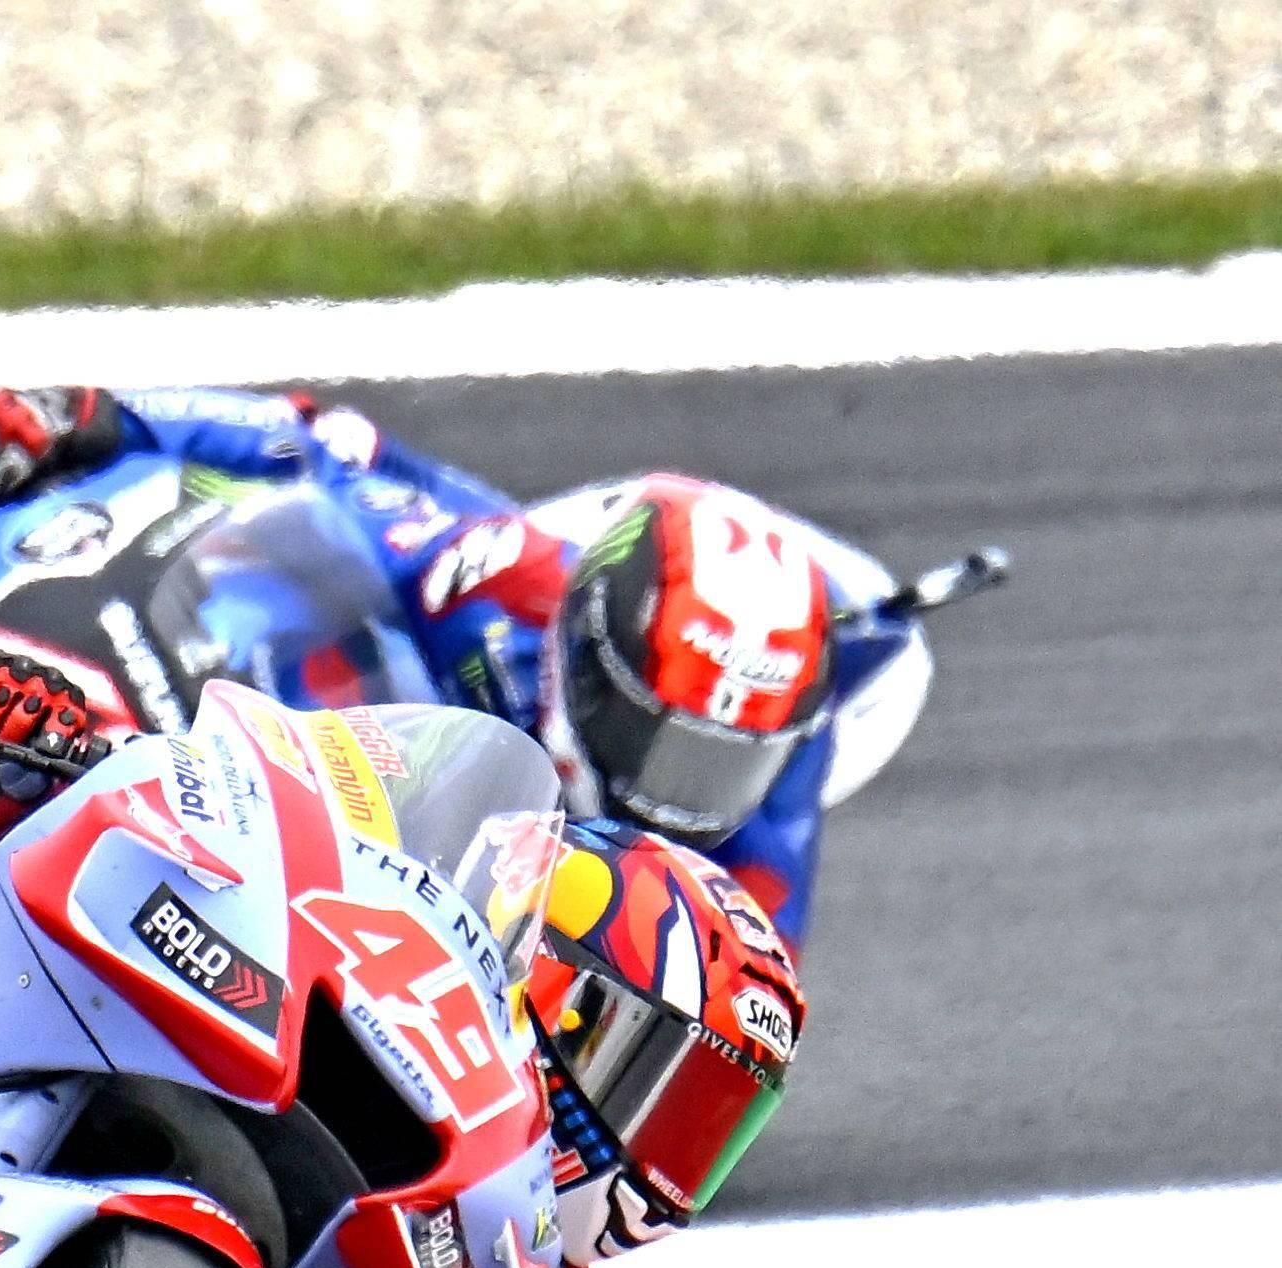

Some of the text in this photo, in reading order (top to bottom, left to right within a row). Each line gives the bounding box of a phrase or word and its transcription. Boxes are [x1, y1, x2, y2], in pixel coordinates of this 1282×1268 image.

[167, 737, 215, 823] Unibat
[351, 836, 442, 907] THE
[141, 921, 215, 990] RIDERS
[150, 900, 233, 977] BOLD
[291, 891, 525, 1130] 49
[687, 1021, 741, 1065] GIVES
[746, 998, 792, 1050] SHOE
